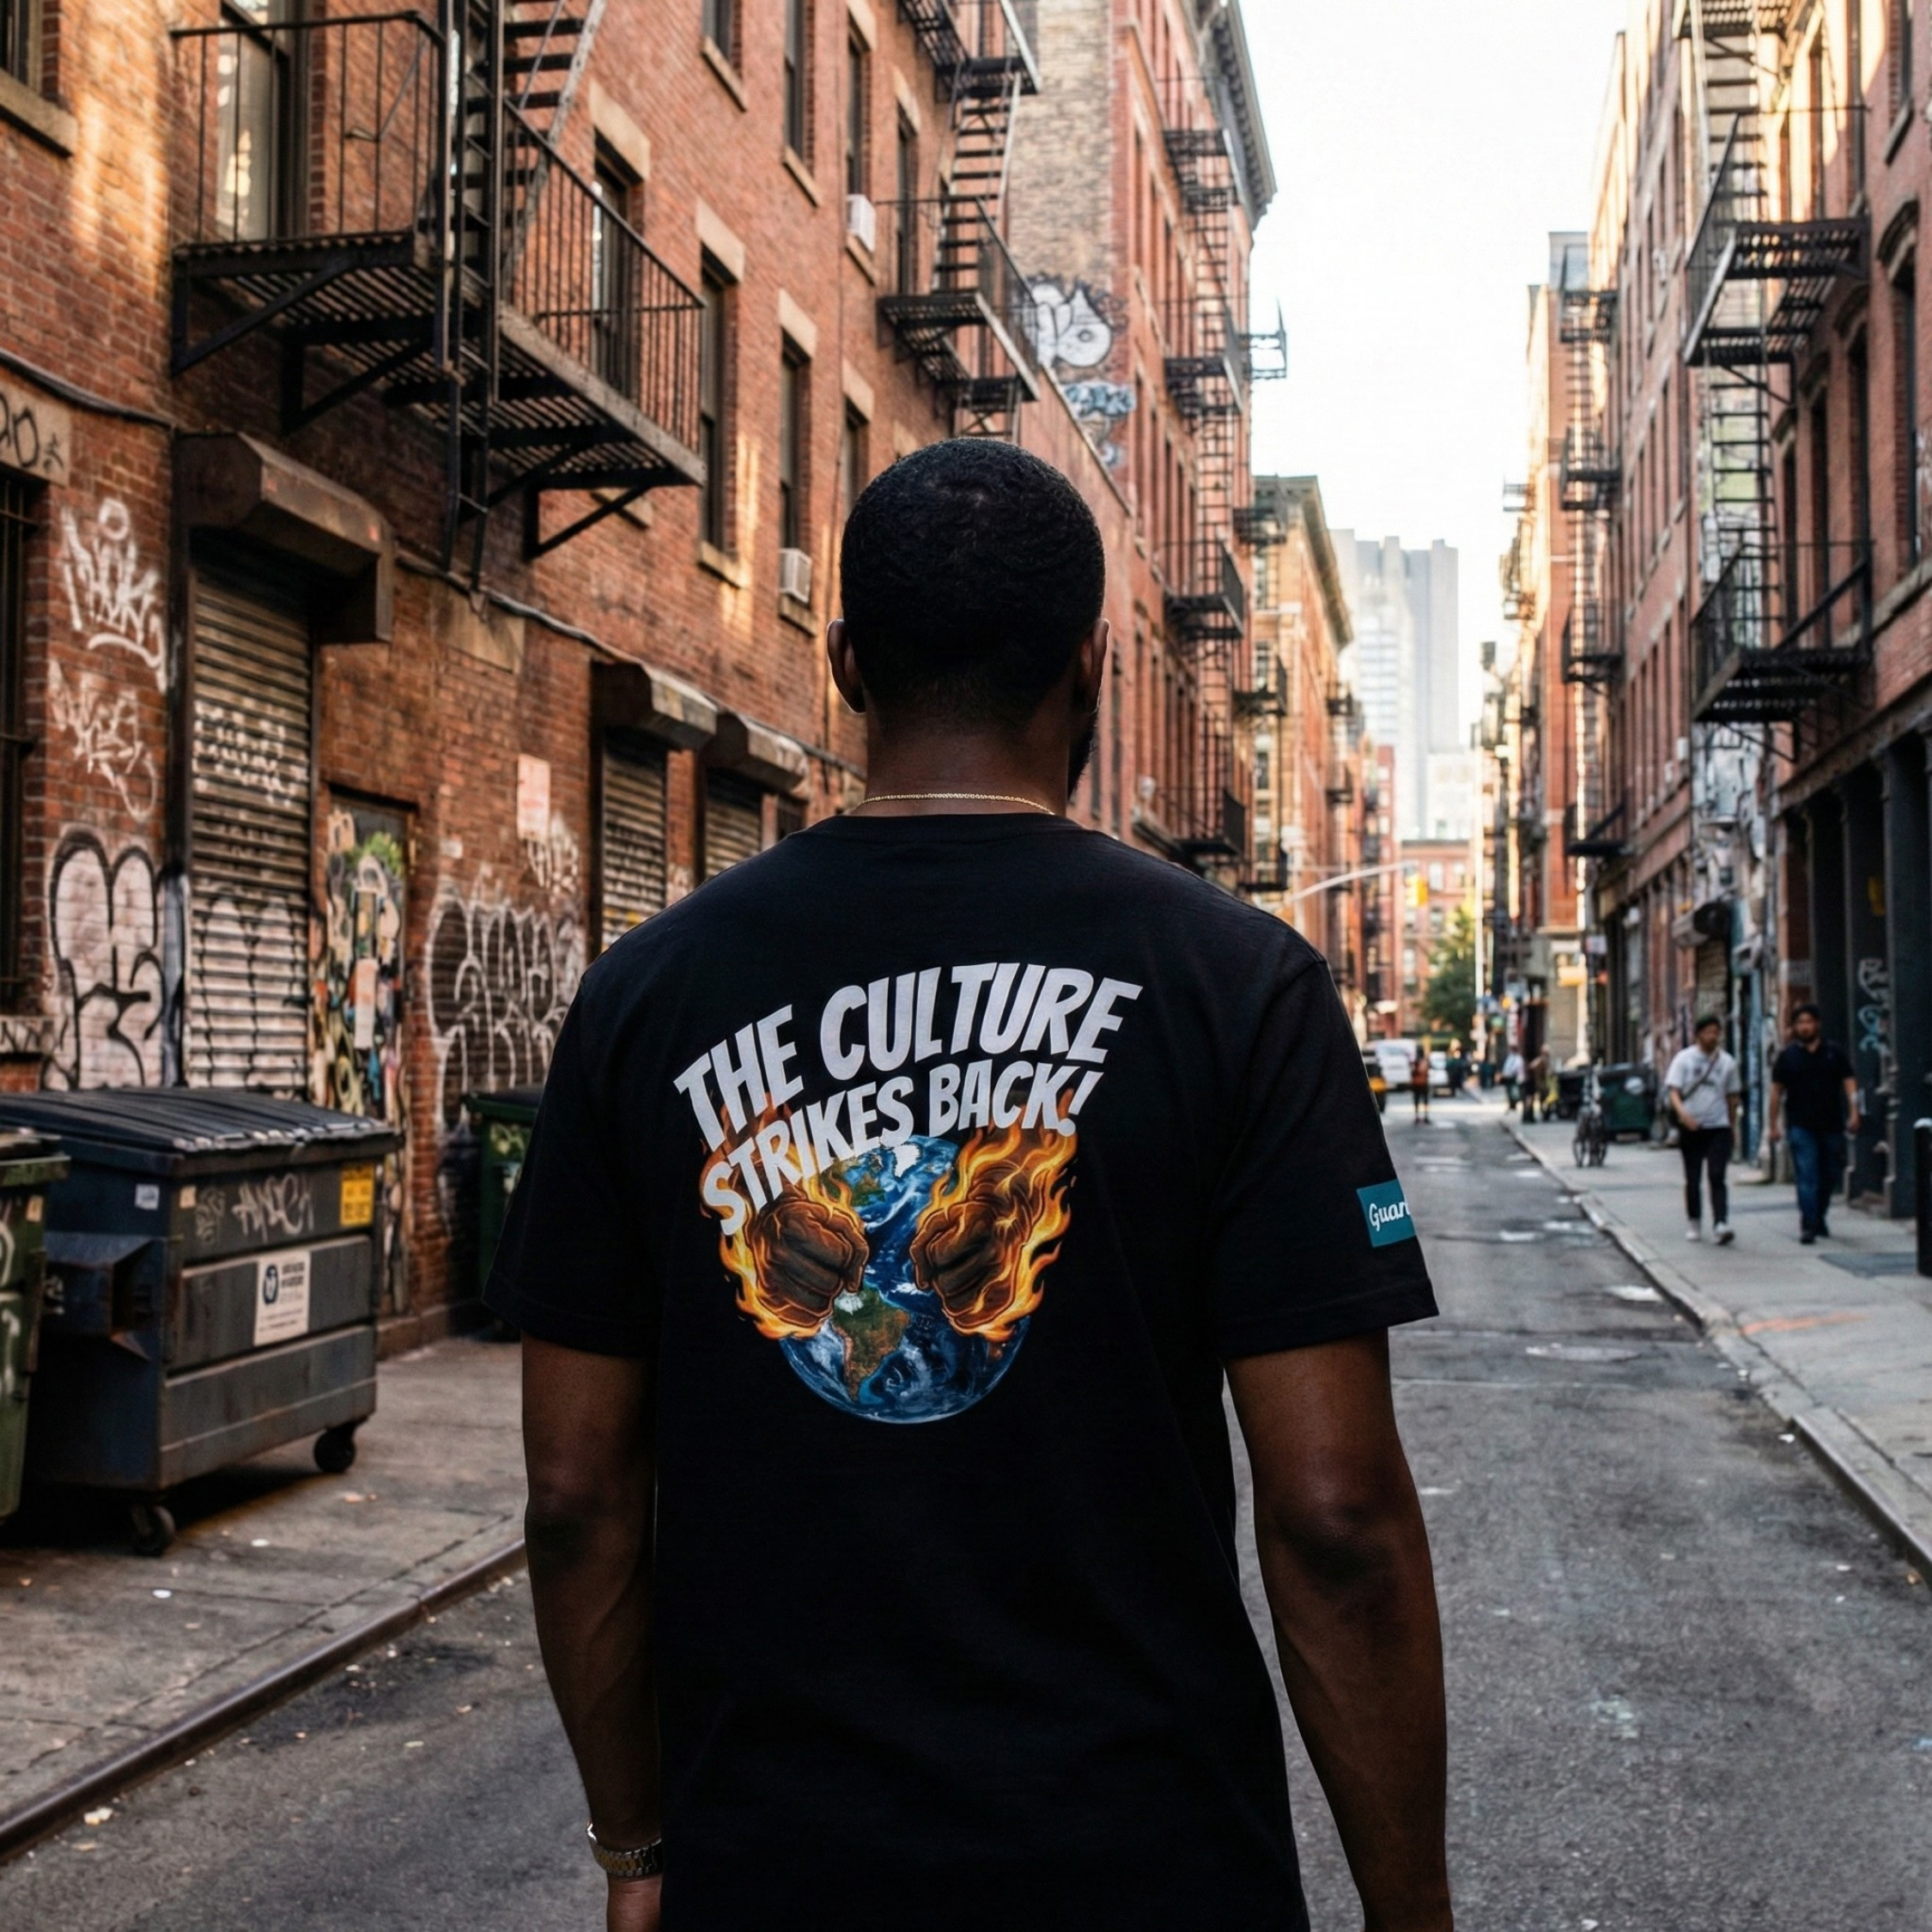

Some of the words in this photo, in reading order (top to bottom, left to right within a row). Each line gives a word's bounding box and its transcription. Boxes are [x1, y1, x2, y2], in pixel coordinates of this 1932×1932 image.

[673, 1004, 804, 1151] THE
[819, 962, 1143, 1081] CULTURE
[702, 1076, 914, 1236] STRIKES
[928, 1060, 1104, 1138] BACK!
